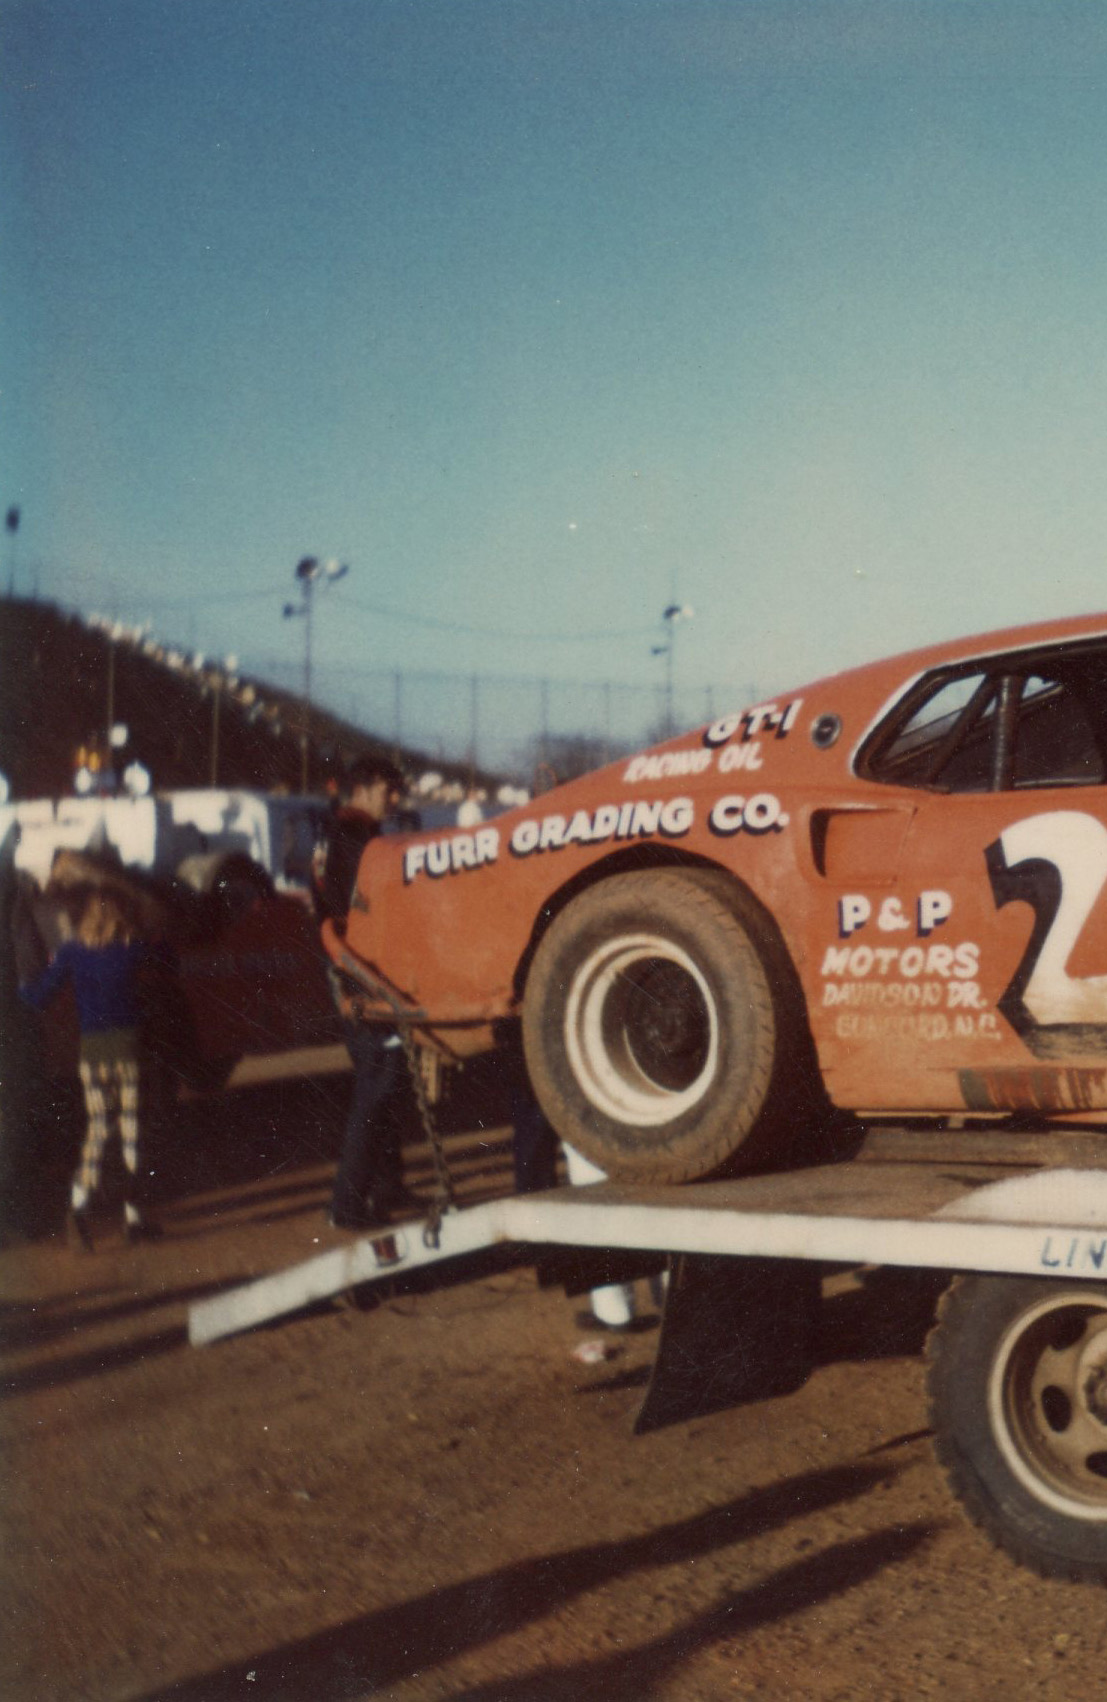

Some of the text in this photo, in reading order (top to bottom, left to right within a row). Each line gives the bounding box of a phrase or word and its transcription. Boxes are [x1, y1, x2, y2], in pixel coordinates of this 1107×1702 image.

[717, 742, 763, 774] OIL
[404, 793, 790, 883] FURR GRADING CO.
[838, 890, 953, 938] P & P
[820, 942, 980, 979] MOTORS
[946, 980, 988, 1009] DR.
